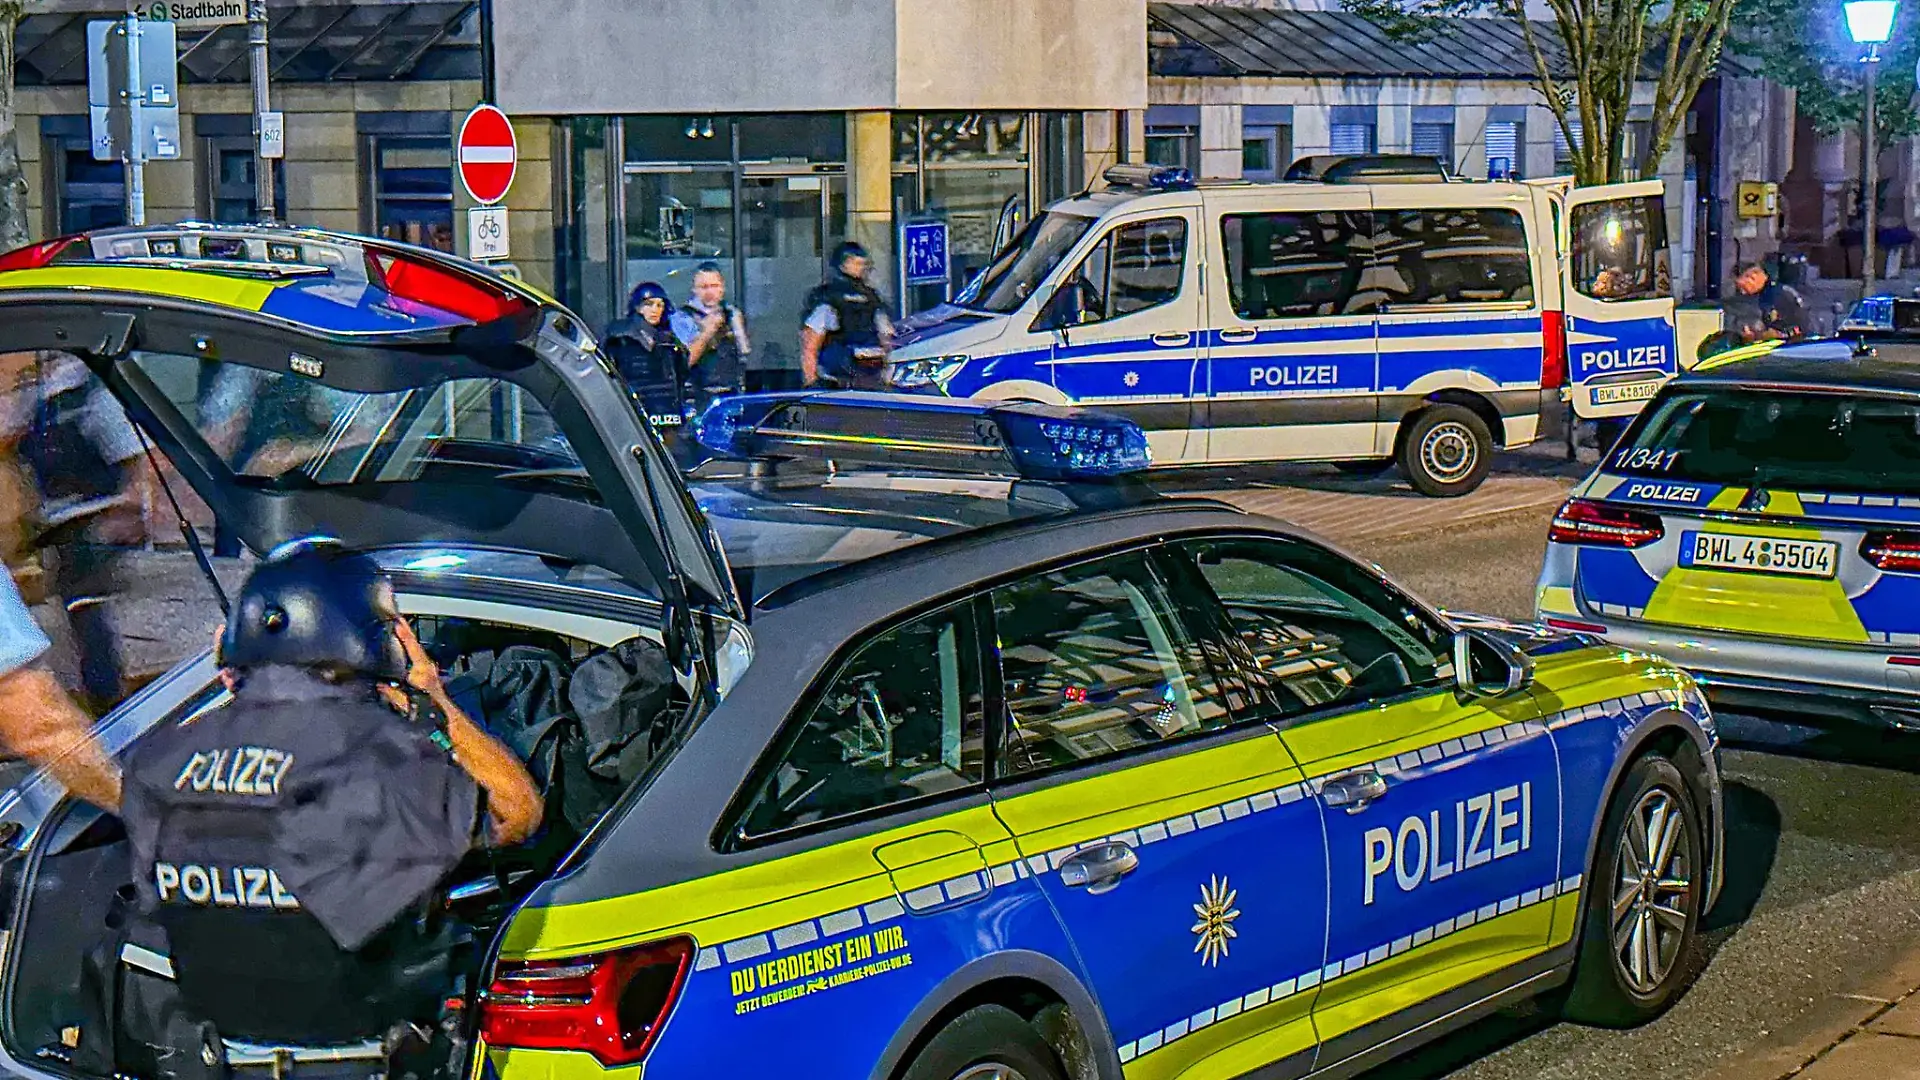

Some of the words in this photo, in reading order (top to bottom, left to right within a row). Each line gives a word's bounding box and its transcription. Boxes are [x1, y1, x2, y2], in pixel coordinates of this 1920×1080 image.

[171, 1, 241, 20] Stadtbahn
[264, 128, 280, 142] 602
[483, 241, 496, 252] frei
[1581, 344, 1667, 371] POLIZEI
[1249, 364, 1338, 386] POLIZEI
[648, 414, 682, 426] OLIZEI
[1615, 447, 1680, 471] 1/341
[1627, 483, 1701, 502] POLIZEI
[1695, 536, 1736, 564] BWL
[1743, 540, 1755, 565] 4
[1773, 543, 1828, 572] 5504
[1363, 781, 1531, 906] POLIZEI
[155, 862, 301, 909] POLIZE
[730, 967, 755, 996] DU
[757, 942, 843, 988] VERDIENST
[846, 934, 872, 963] EIN
[873, 925, 909, 955] WIR.
[735, 997, 760, 1015] JETZT
